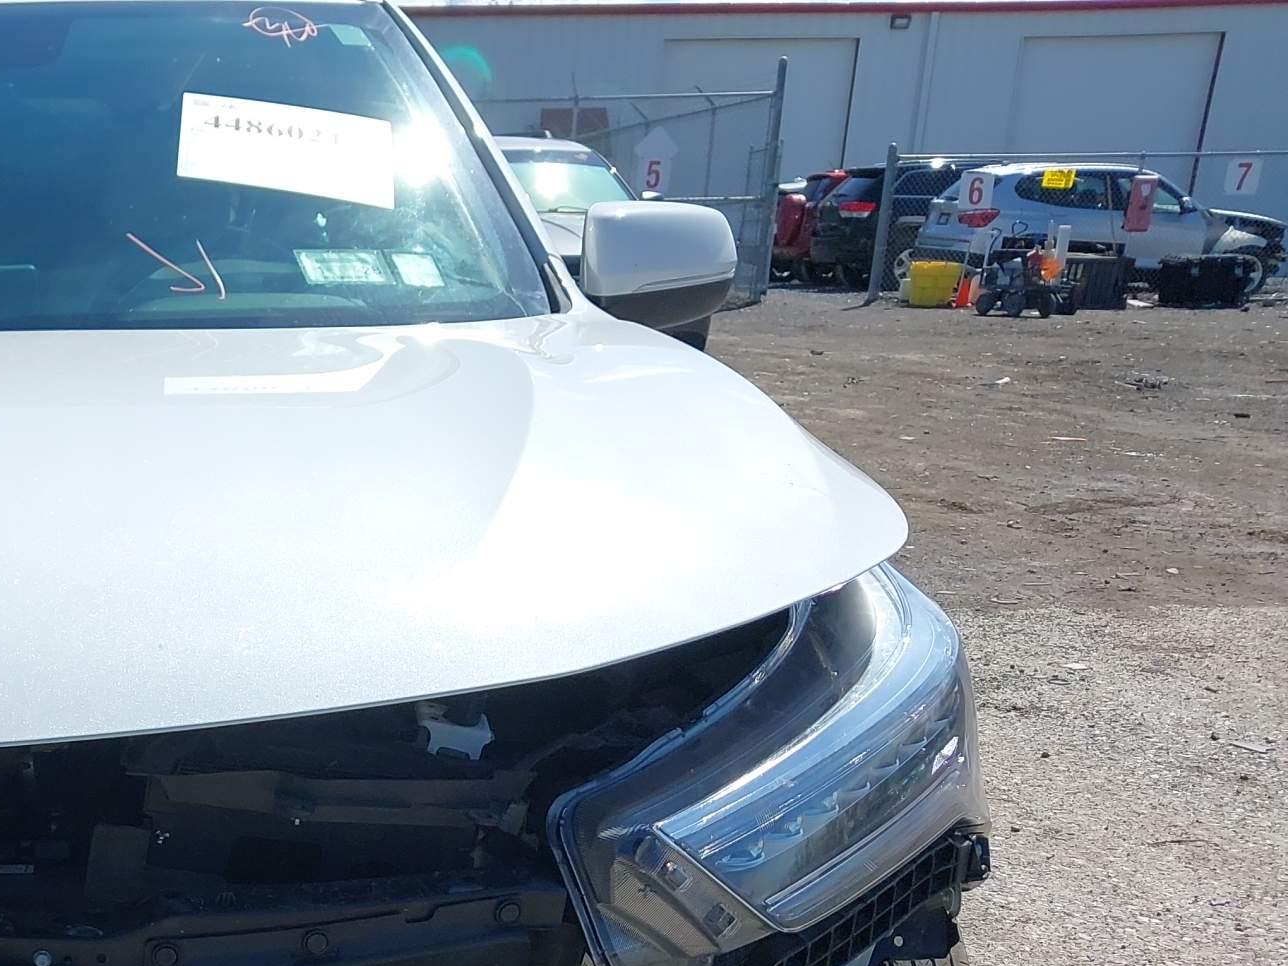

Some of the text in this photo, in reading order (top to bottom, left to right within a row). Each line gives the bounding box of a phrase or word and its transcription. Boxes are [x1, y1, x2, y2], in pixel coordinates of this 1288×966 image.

[645, 160, 663, 189] 5
[1235, 161, 1254, 191] 7
[968, 176, 985, 206] 6
